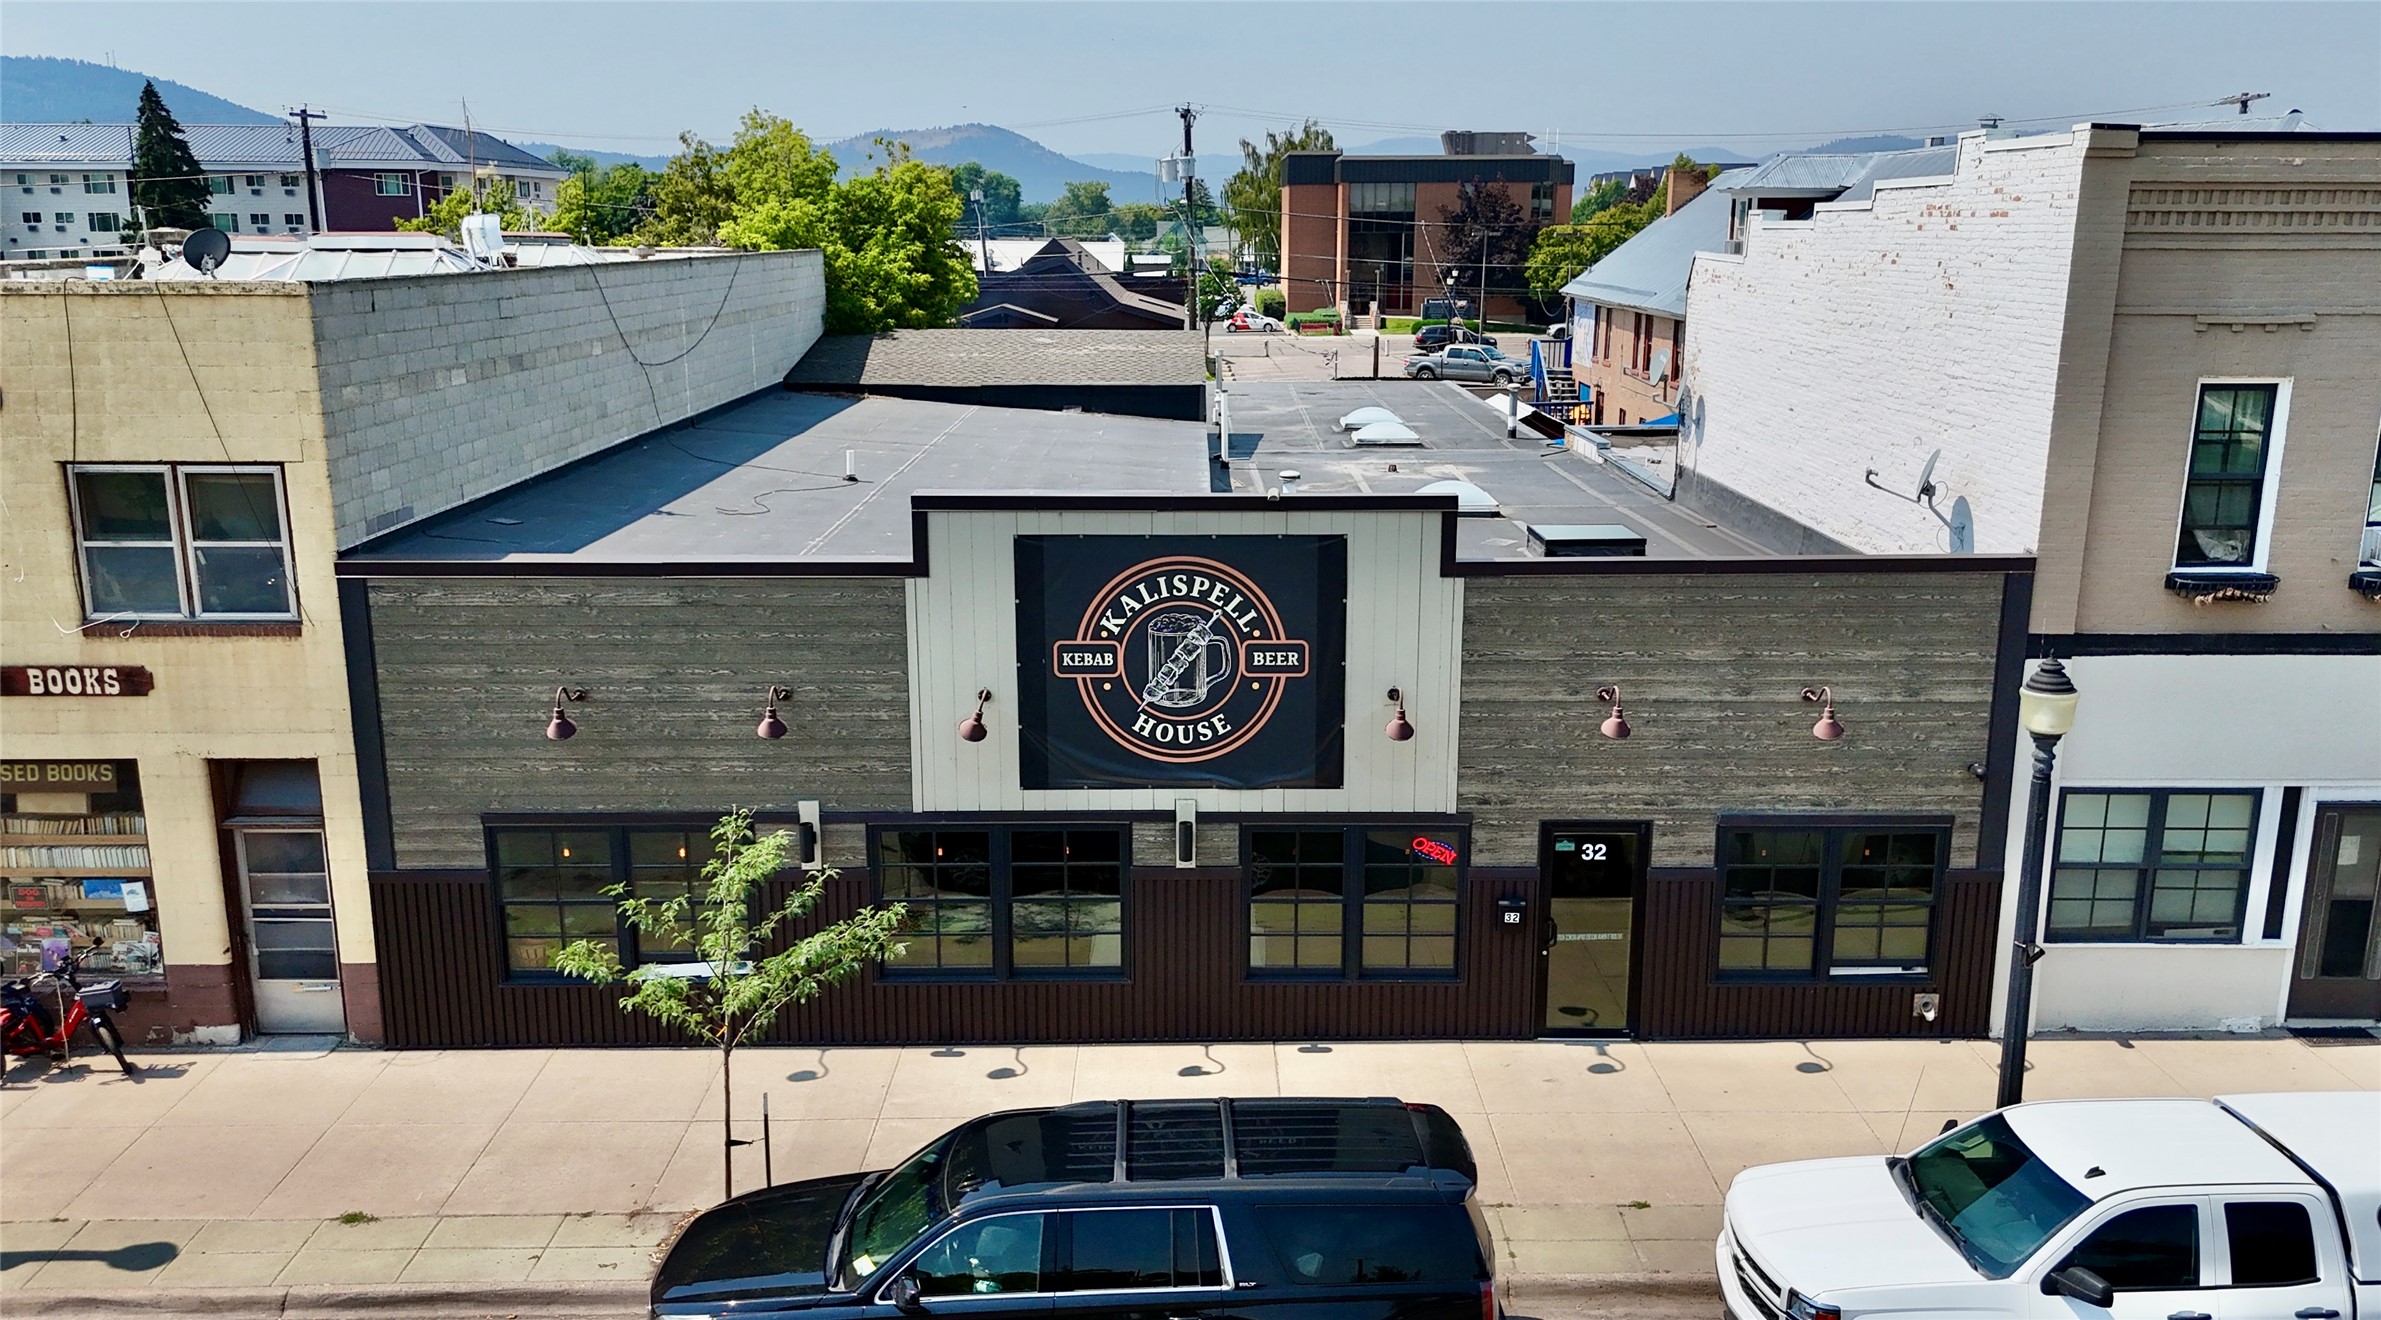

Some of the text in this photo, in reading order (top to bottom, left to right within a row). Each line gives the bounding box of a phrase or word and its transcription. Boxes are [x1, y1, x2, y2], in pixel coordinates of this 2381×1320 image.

[1100, 575, 1258, 635] KALISPELL
[1062, 652, 1114, 667] KEBAB
[1252, 651, 1299, 667] BEER
[26, 668, 121, 695] BOOKS
[1131, 713, 1232, 745] HOUSE
[47, 764, 113, 782] BOOKS
[1412, 837, 1457, 865] OPEN
[1581, 843, 1607, 861] 32
[1505, 913, 1519, 922] 32
